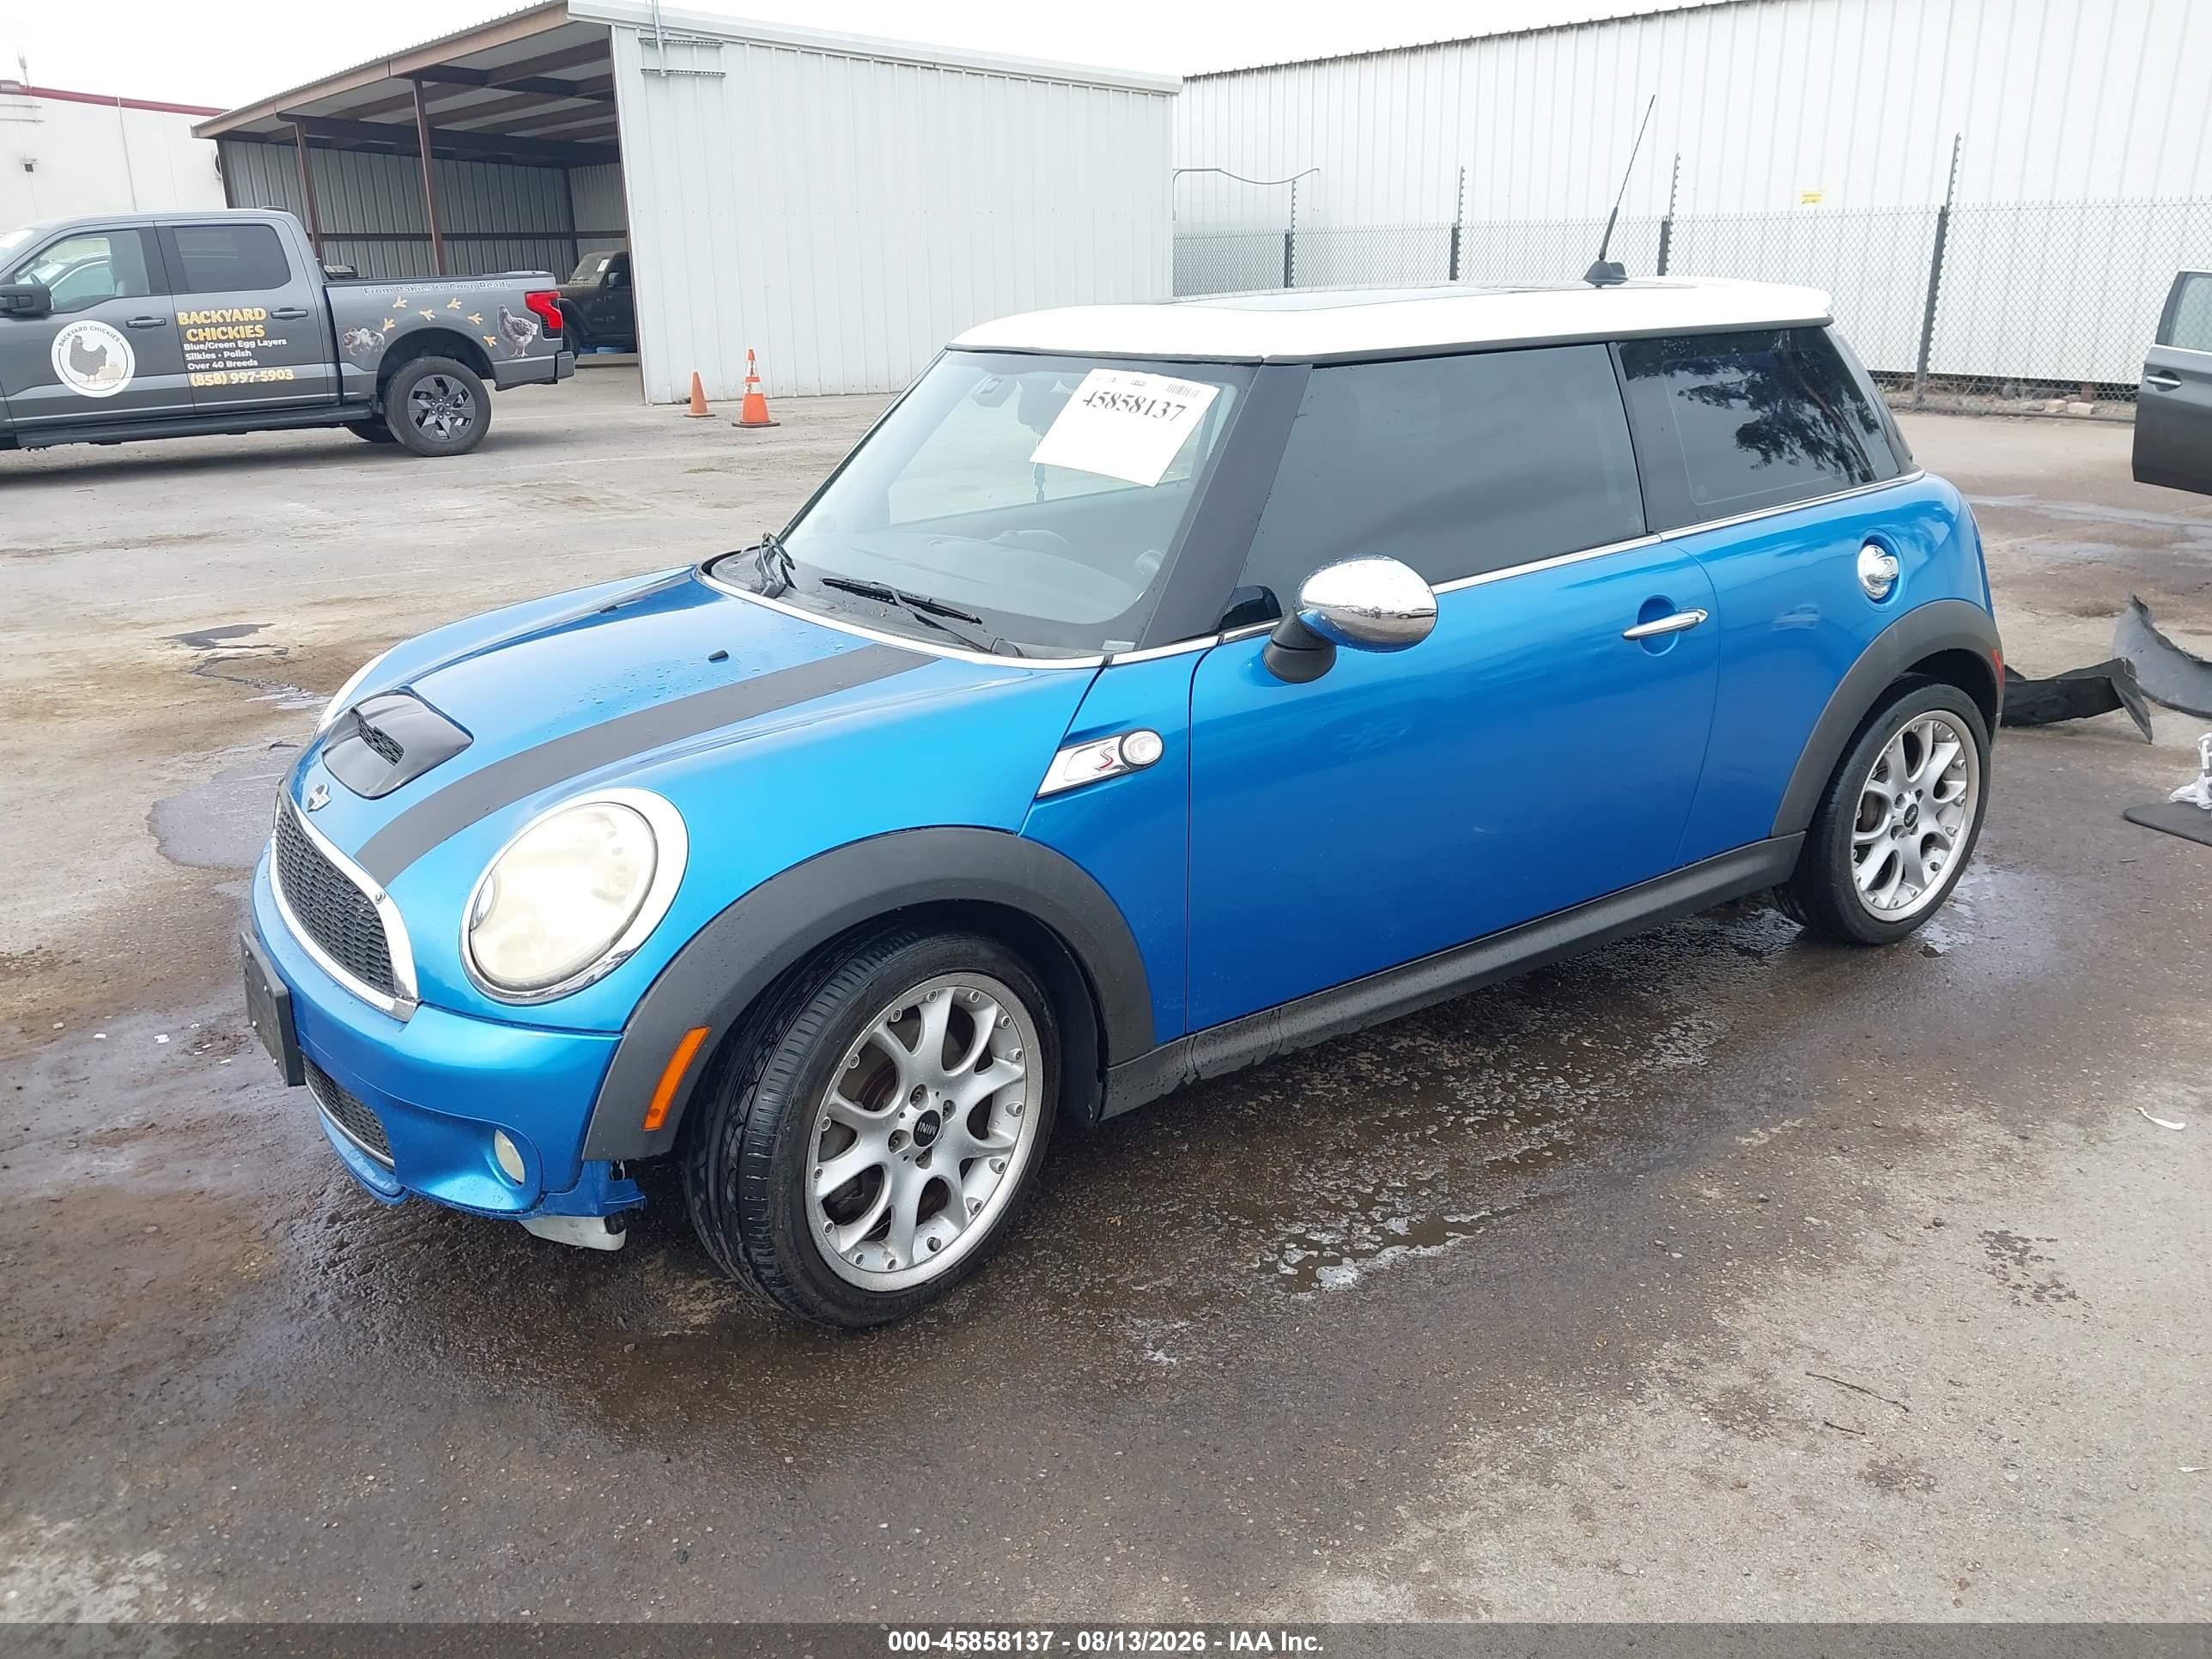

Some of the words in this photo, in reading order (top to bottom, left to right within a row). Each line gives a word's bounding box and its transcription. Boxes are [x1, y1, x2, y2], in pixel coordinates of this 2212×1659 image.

[178, 307, 266, 325] BACKYARD
[58, 325, 88, 347] BACKYARD
[90, 325, 120, 343] CHICKIES
[186, 325, 265, 342] CHICKIES
[184, 341, 235, 351] Blue/Green
[238, 340, 255, 349] Egg
[258, 337, 287, 348] Layers
[185, 352, 216, 361] Silkies
[223, 349, 252, 358] Polish
[187, 362, 210, 370] Over
[212, 361, 224, 369] 40
[227, 359, 258, 368] Breeds
[190, 371, 227, 386] (858)
[231, 368, 295, 384] 997-5903
[1083, 390, 1187, 422] 45858137
[917, 1121, 938, 1135] MINI
